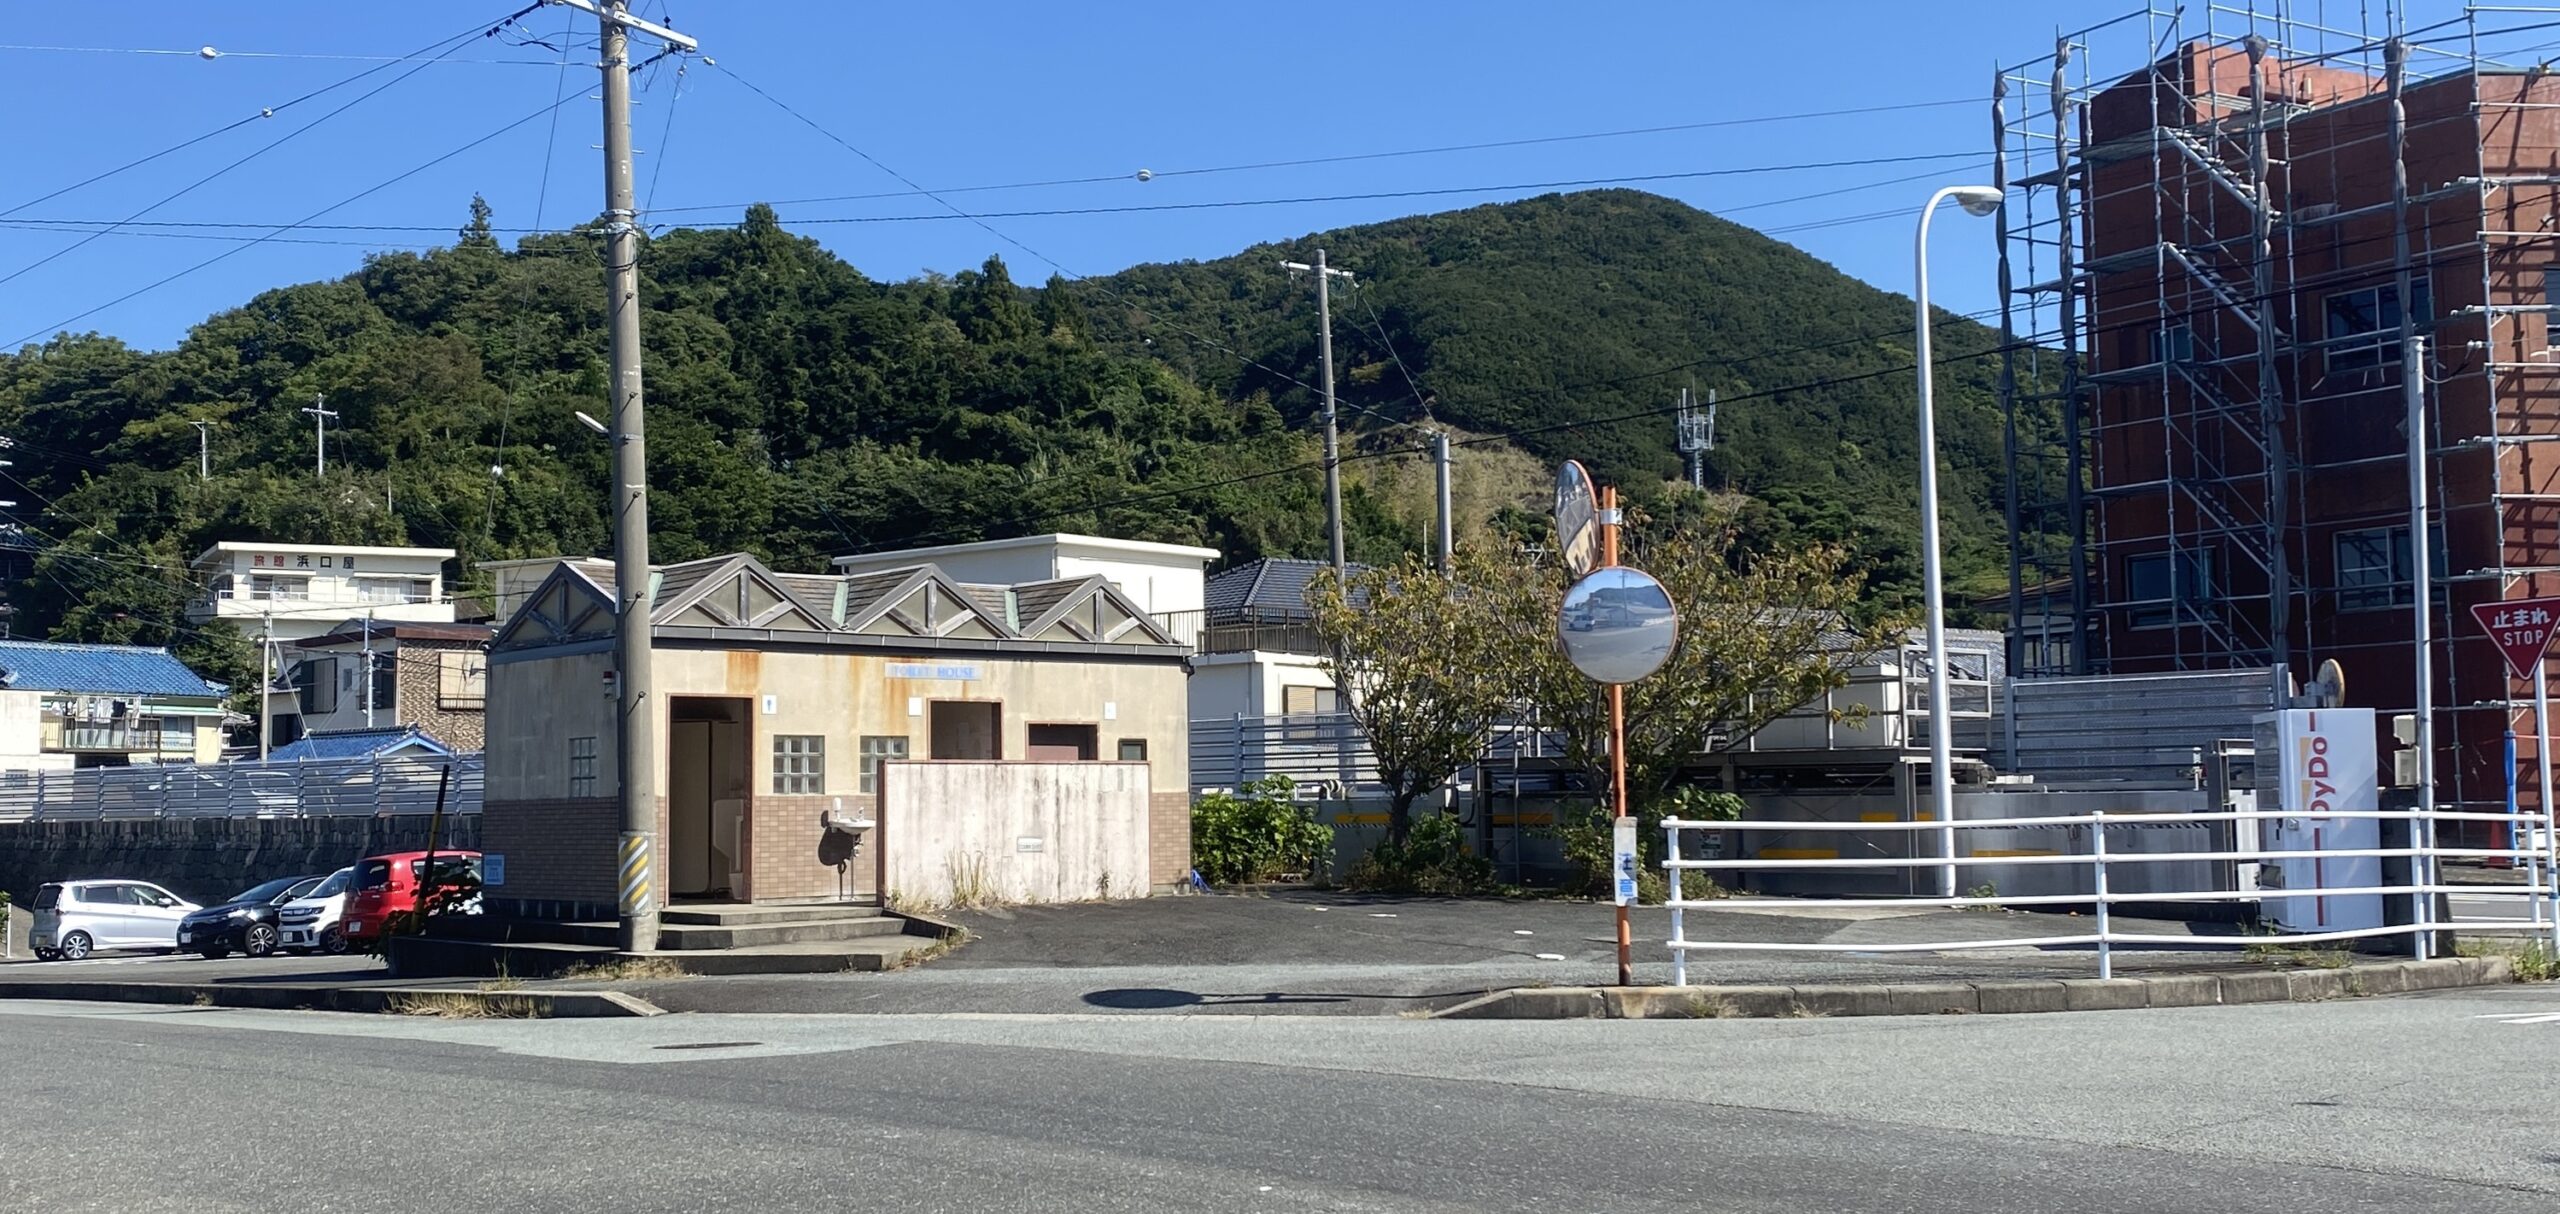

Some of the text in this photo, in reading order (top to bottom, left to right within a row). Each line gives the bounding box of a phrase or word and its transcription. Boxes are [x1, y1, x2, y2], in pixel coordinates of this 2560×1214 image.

[296, 555, 354, 569] 浜口屋
[2492, 607, 2551, 629] 止まれ
[2503, 629, 2544, 647] STOP
[937, 666, 975, 678] HOUSE
[2308, 736, 2337, 822] DyDo
